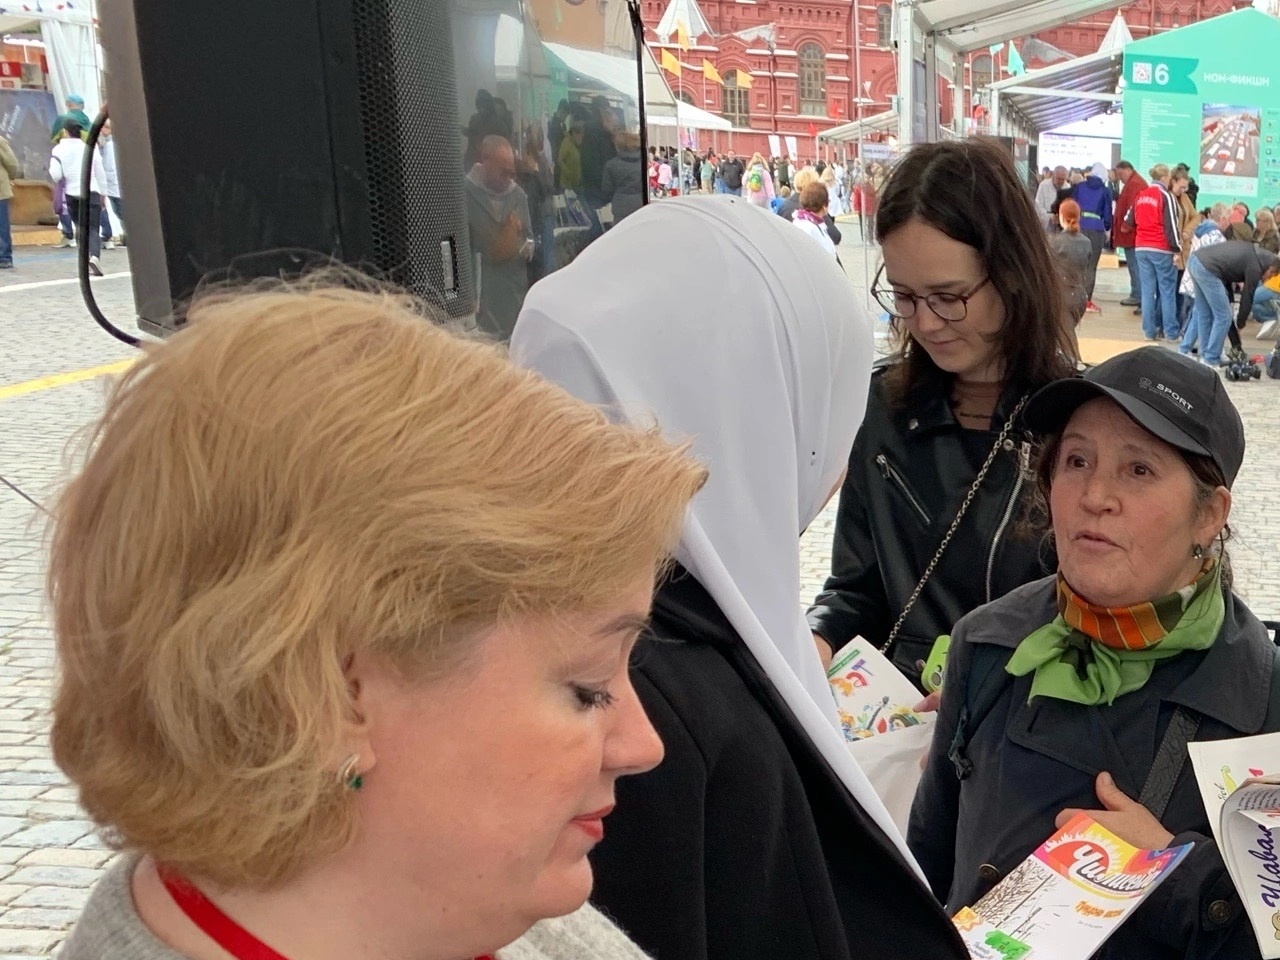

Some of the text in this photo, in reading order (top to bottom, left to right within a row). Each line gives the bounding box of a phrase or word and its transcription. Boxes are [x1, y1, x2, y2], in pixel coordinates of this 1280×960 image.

[1154, 63, 1170, 85] 6
[1203, 72, 1270, 87] НОН-ФИКШН
[1156, 383, 1194, 411] SPORT
